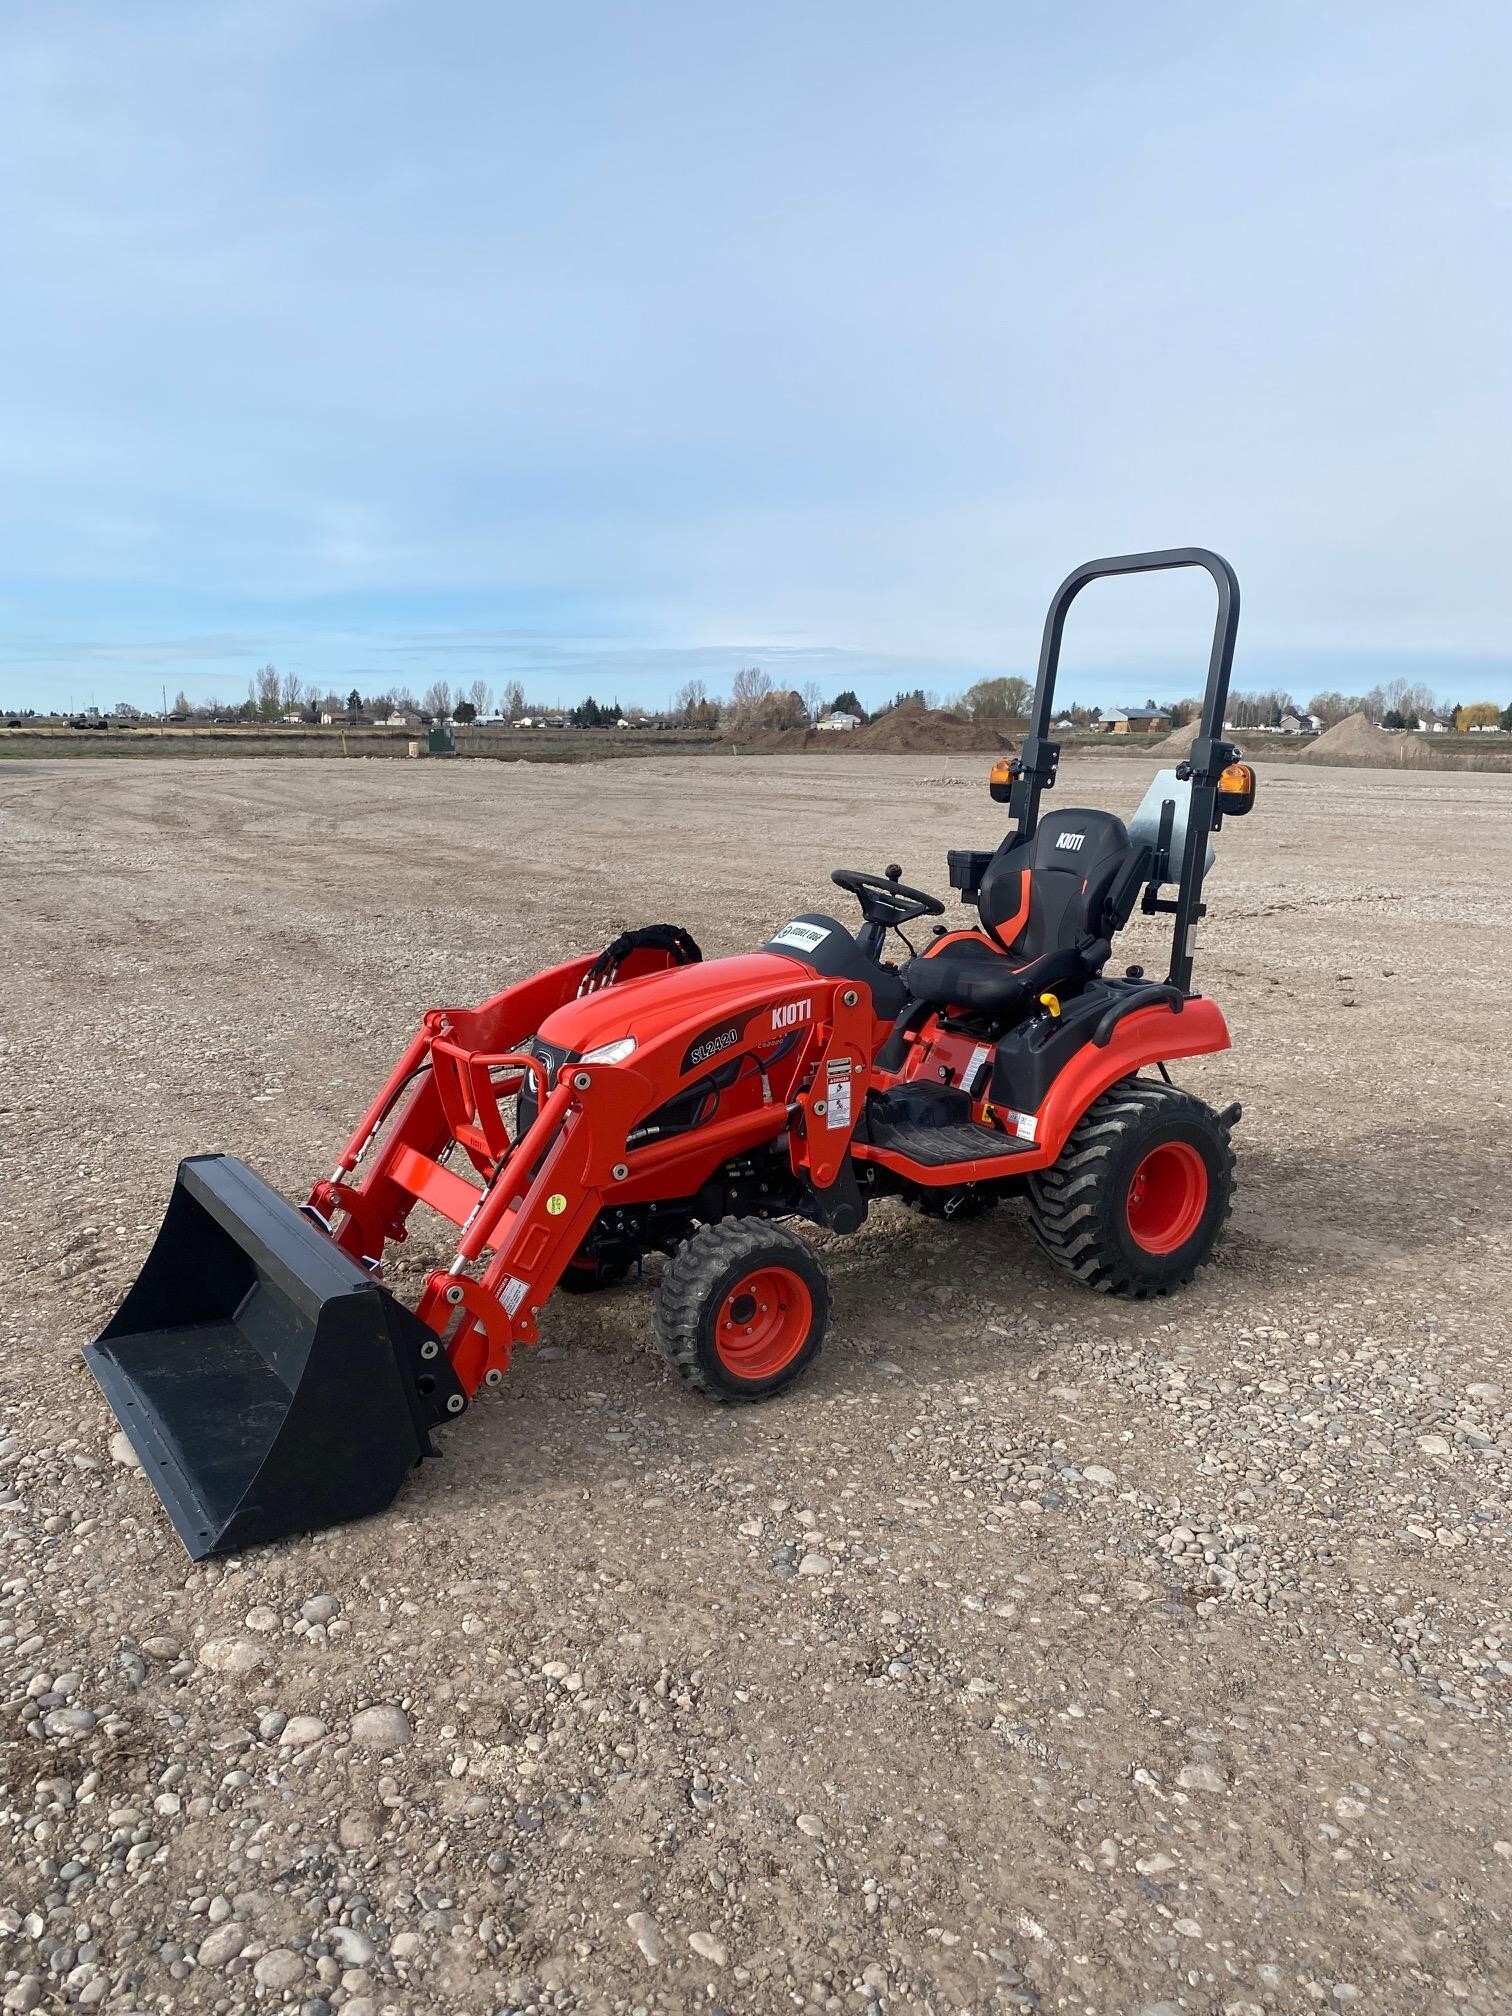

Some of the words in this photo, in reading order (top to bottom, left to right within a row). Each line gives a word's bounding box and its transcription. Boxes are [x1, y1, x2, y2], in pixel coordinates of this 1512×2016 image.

[1055, 832, 1086, 851] KIOTI
[771, 998, 812, 1030] KIOTI
[690, 1028, 738, 1064] SL2420
